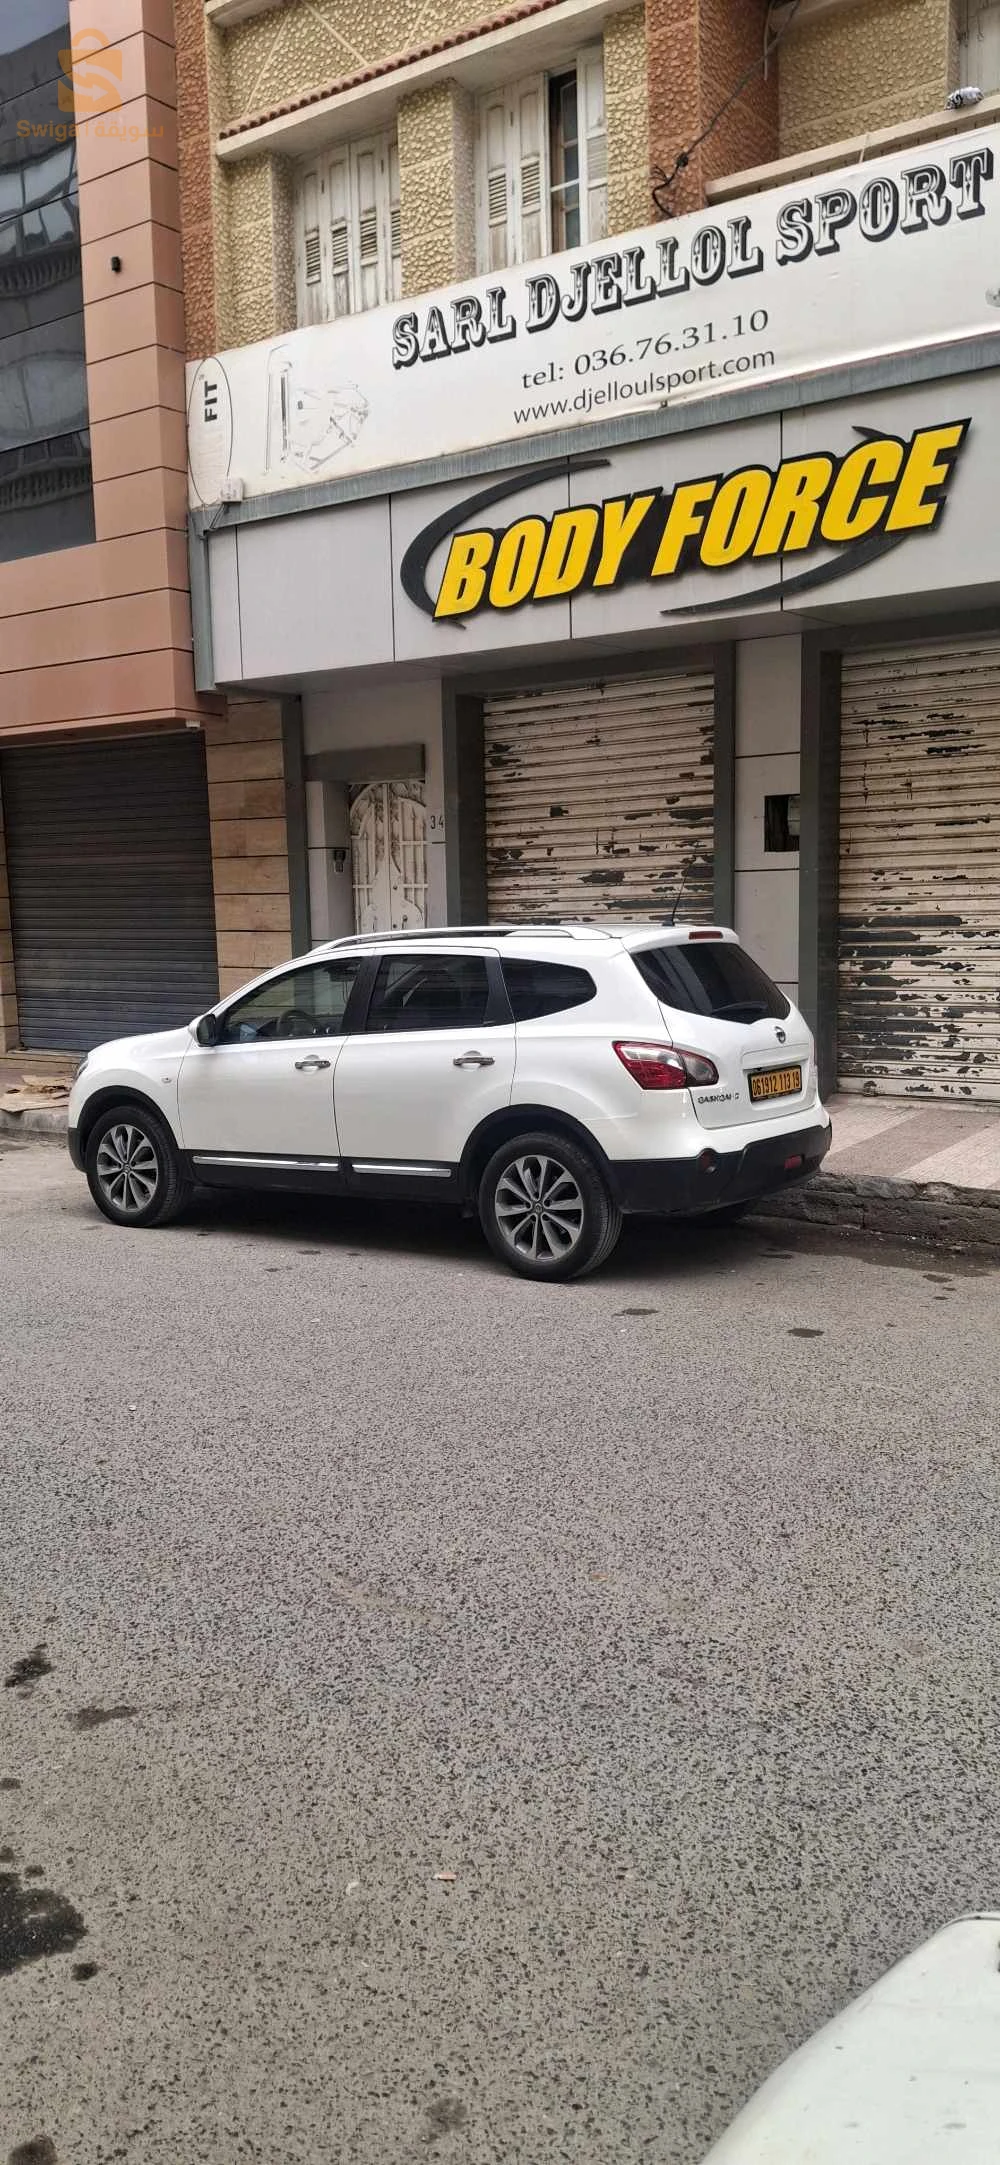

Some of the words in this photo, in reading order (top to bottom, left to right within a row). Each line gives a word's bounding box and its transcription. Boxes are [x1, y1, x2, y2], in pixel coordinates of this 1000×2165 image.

[392, 286, 516, 369] SARL
[525, 216, 763, 334] DJELLOL
[775, 147, 994, 266] SPORT
[513, 350, 776, 425] www.djelloulsport.com
[522, 363, 564, 389] tel:
[574, 309, 769, 376] 036.76.31.10
[204, 380, 218, 423] FIT
[432, 490, 658, 622] BODY
[648, 420, 968, 580] FORCE
[430, 815, 445, 830] 34
